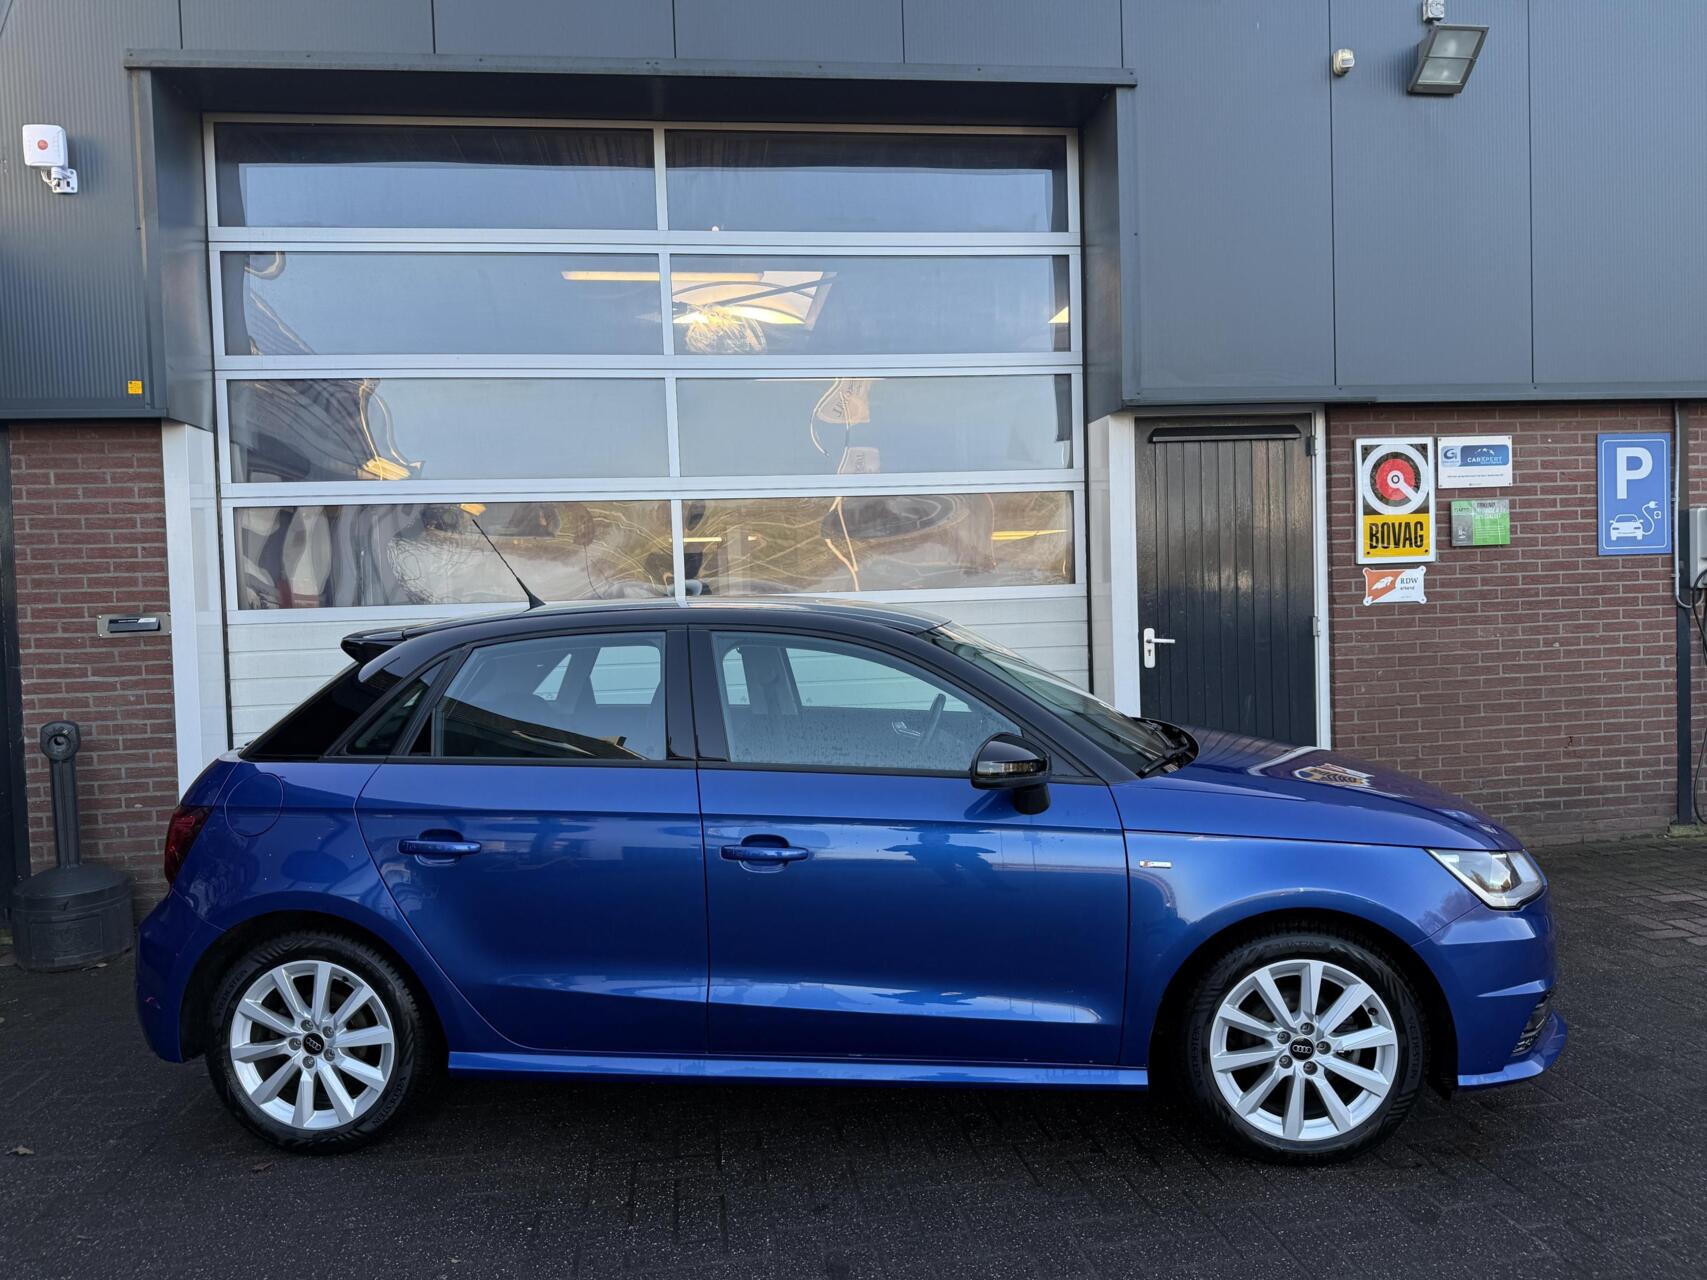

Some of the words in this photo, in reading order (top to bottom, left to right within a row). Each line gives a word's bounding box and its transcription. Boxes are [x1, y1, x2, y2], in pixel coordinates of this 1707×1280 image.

[1616, 447, 1653, 500] P
[1369, 521, 1424, 549] BOVAG
[1400, 577, 1419, 585] RDW
